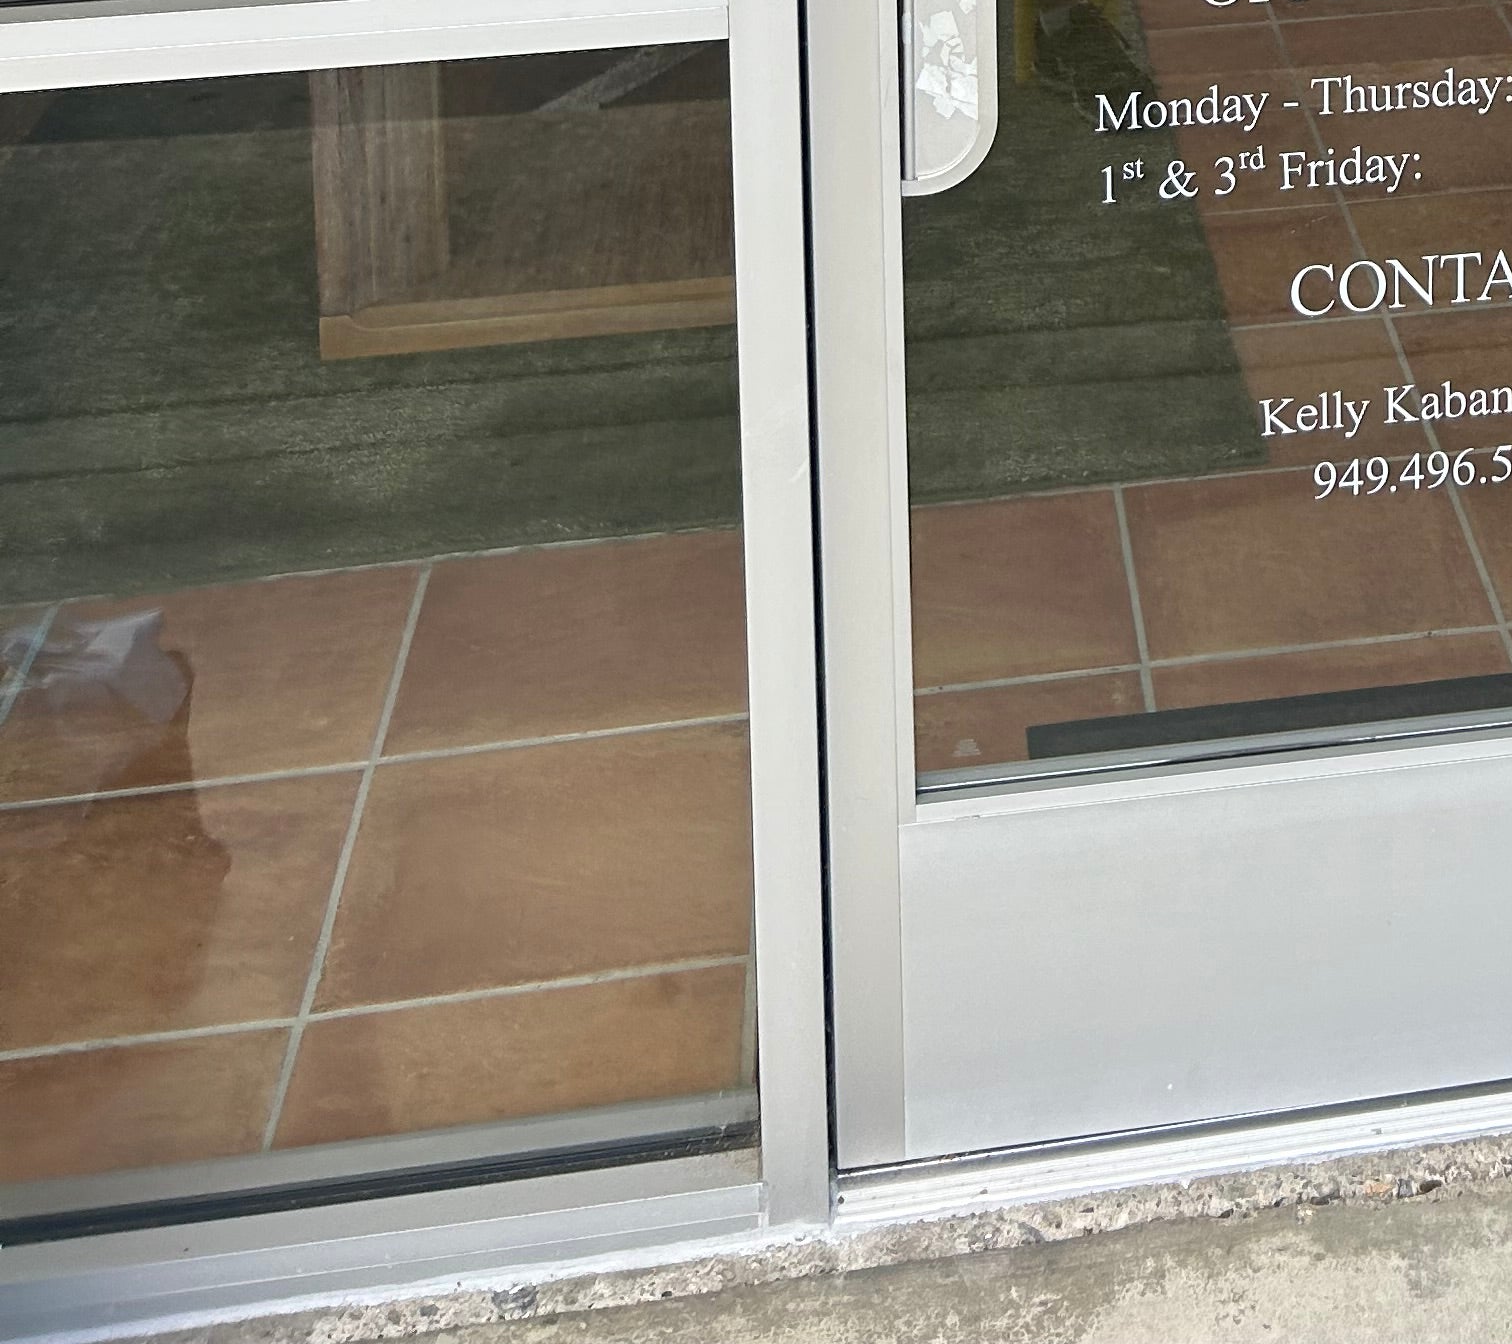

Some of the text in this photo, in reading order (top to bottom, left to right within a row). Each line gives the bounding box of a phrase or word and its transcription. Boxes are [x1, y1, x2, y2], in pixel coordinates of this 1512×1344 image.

[1095, 89, 1270, 133] Monday
[1101, 159, 1145, 203] 1st
[1159, 161, 1198, 199] &
[1214, 145, 1266, 196] 3rd
[1279, 150, 1423, 193] Friday:
[1259, 391, 1369, 437] Kelly
